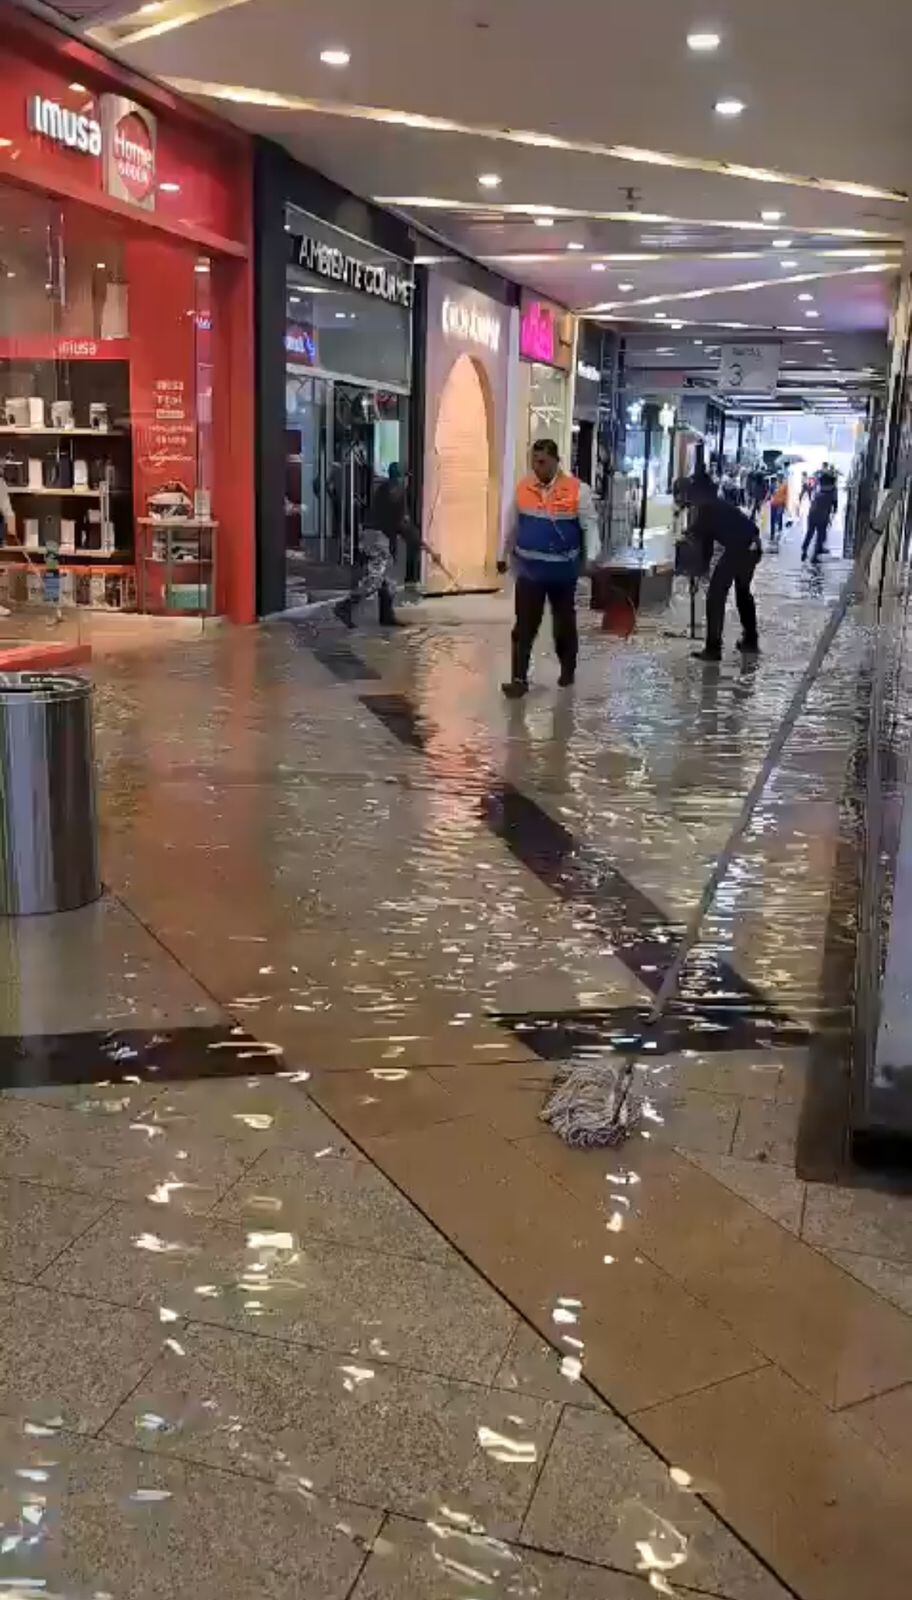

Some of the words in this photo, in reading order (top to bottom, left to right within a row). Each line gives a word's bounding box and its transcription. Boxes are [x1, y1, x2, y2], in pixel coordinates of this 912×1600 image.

[114, 127, 153, 168] Home
[298, 233, 362, 289] AMBIENTE
[728, 363, 744, 387] 3
